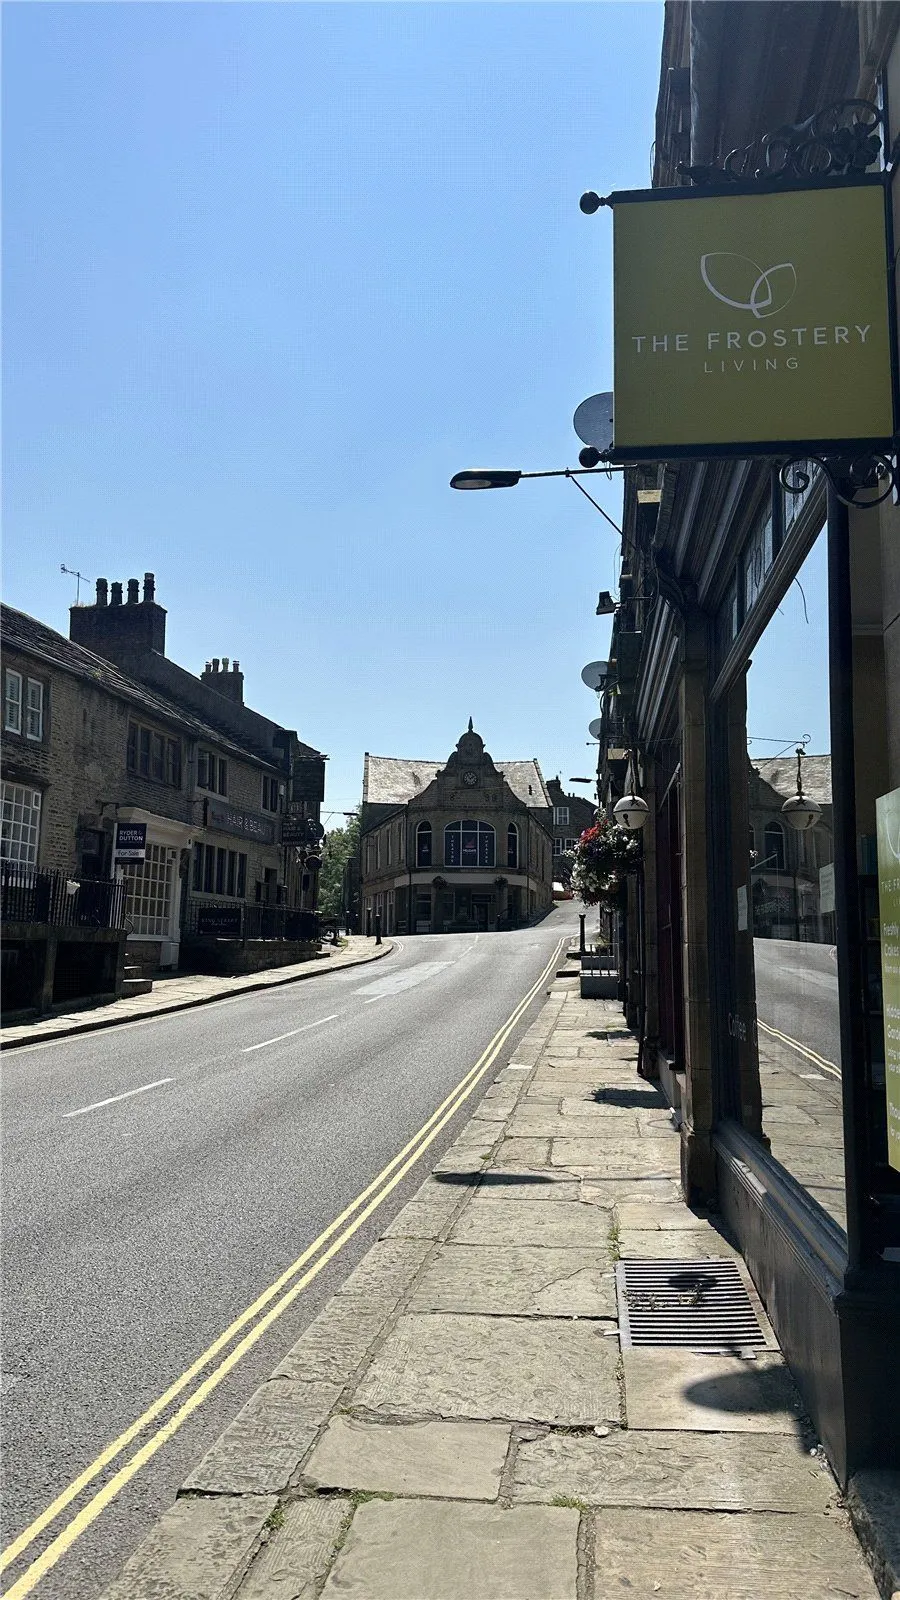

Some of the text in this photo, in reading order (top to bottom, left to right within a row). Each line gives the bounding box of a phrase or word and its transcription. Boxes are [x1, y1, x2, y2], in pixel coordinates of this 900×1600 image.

[632, 325, 871, 353] THE FROSTERY
[704, 358, 799, 373] LIVING
[127, 849, 139, 857] Sale
